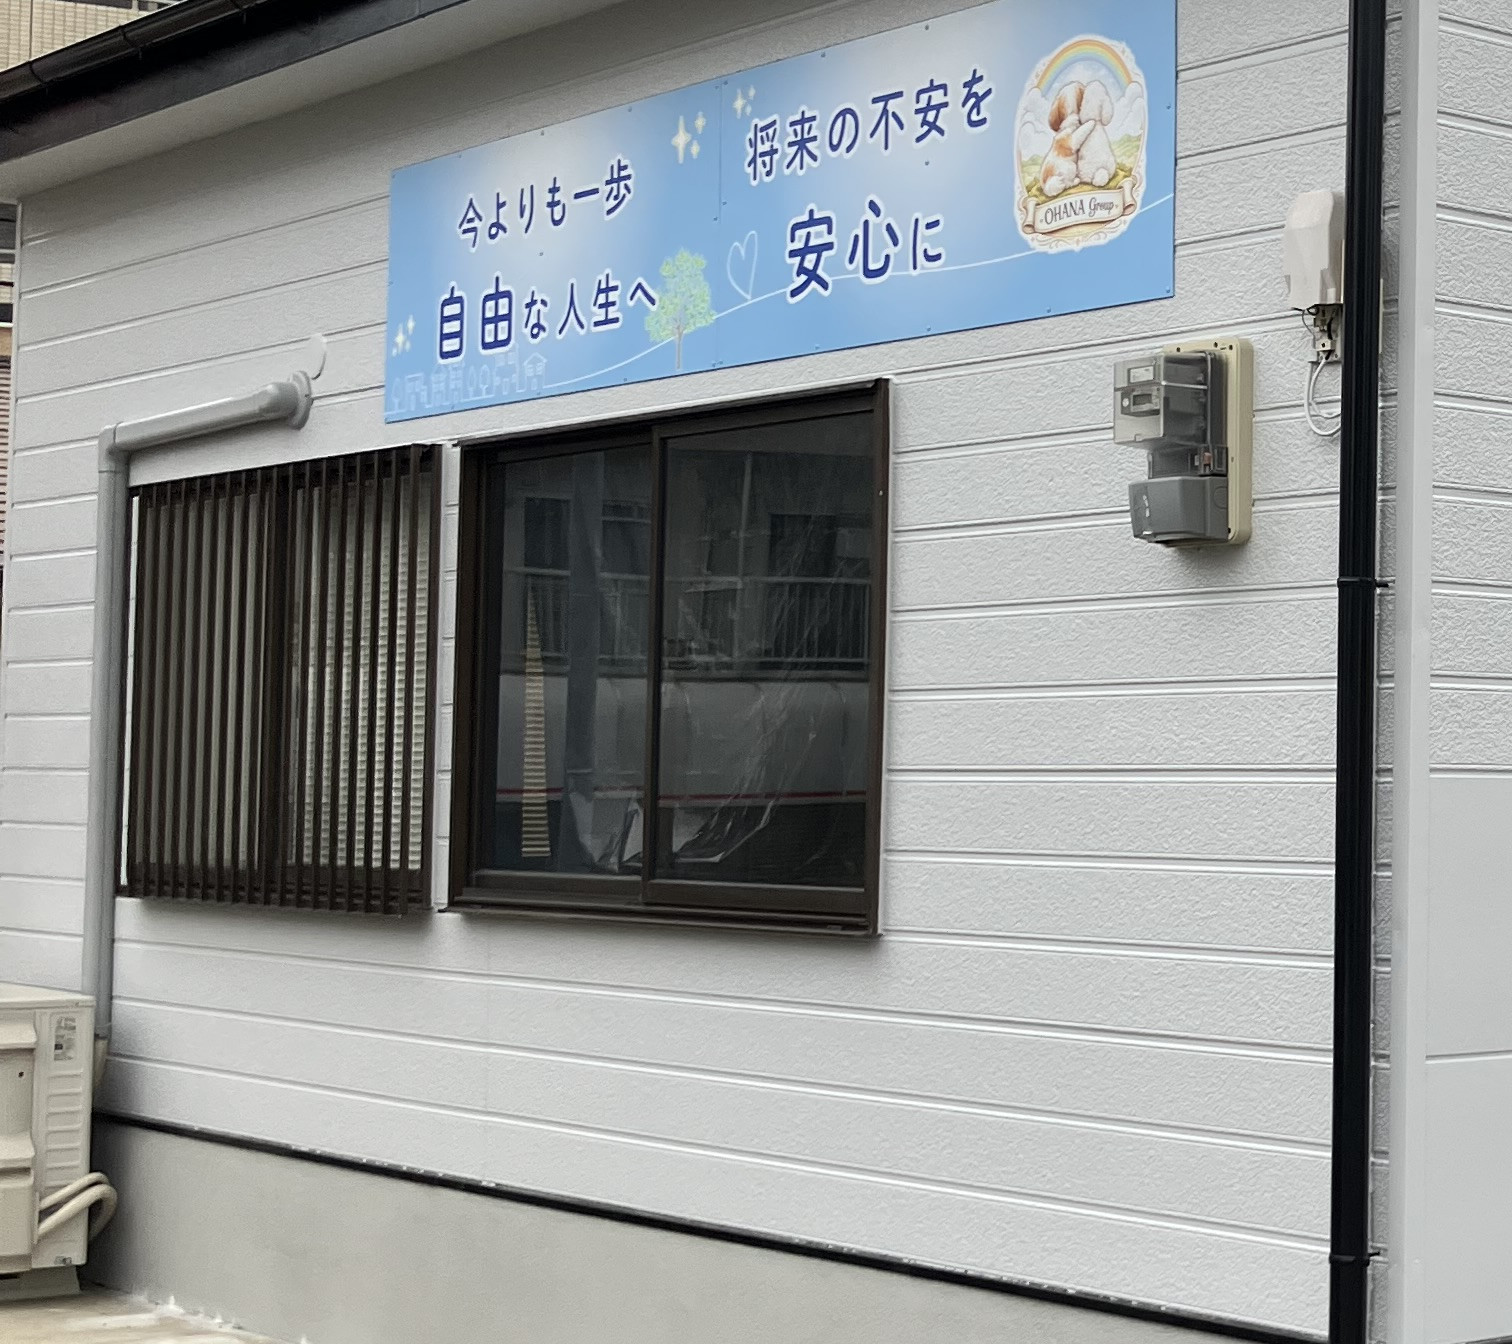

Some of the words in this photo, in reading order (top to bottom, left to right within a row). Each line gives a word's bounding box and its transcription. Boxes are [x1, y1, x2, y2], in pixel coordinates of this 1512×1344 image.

[746, 70, 994, 182] 将来の不安を
[457, 160, 634, 249] 今よりも一歩
[1044, 199, 1086, 225] OHANA
[1089, 197, 1114, 217] Group
[787, 202, 943, 299] 安心に
[437, 274, 658, 361] 自由な人生へ
